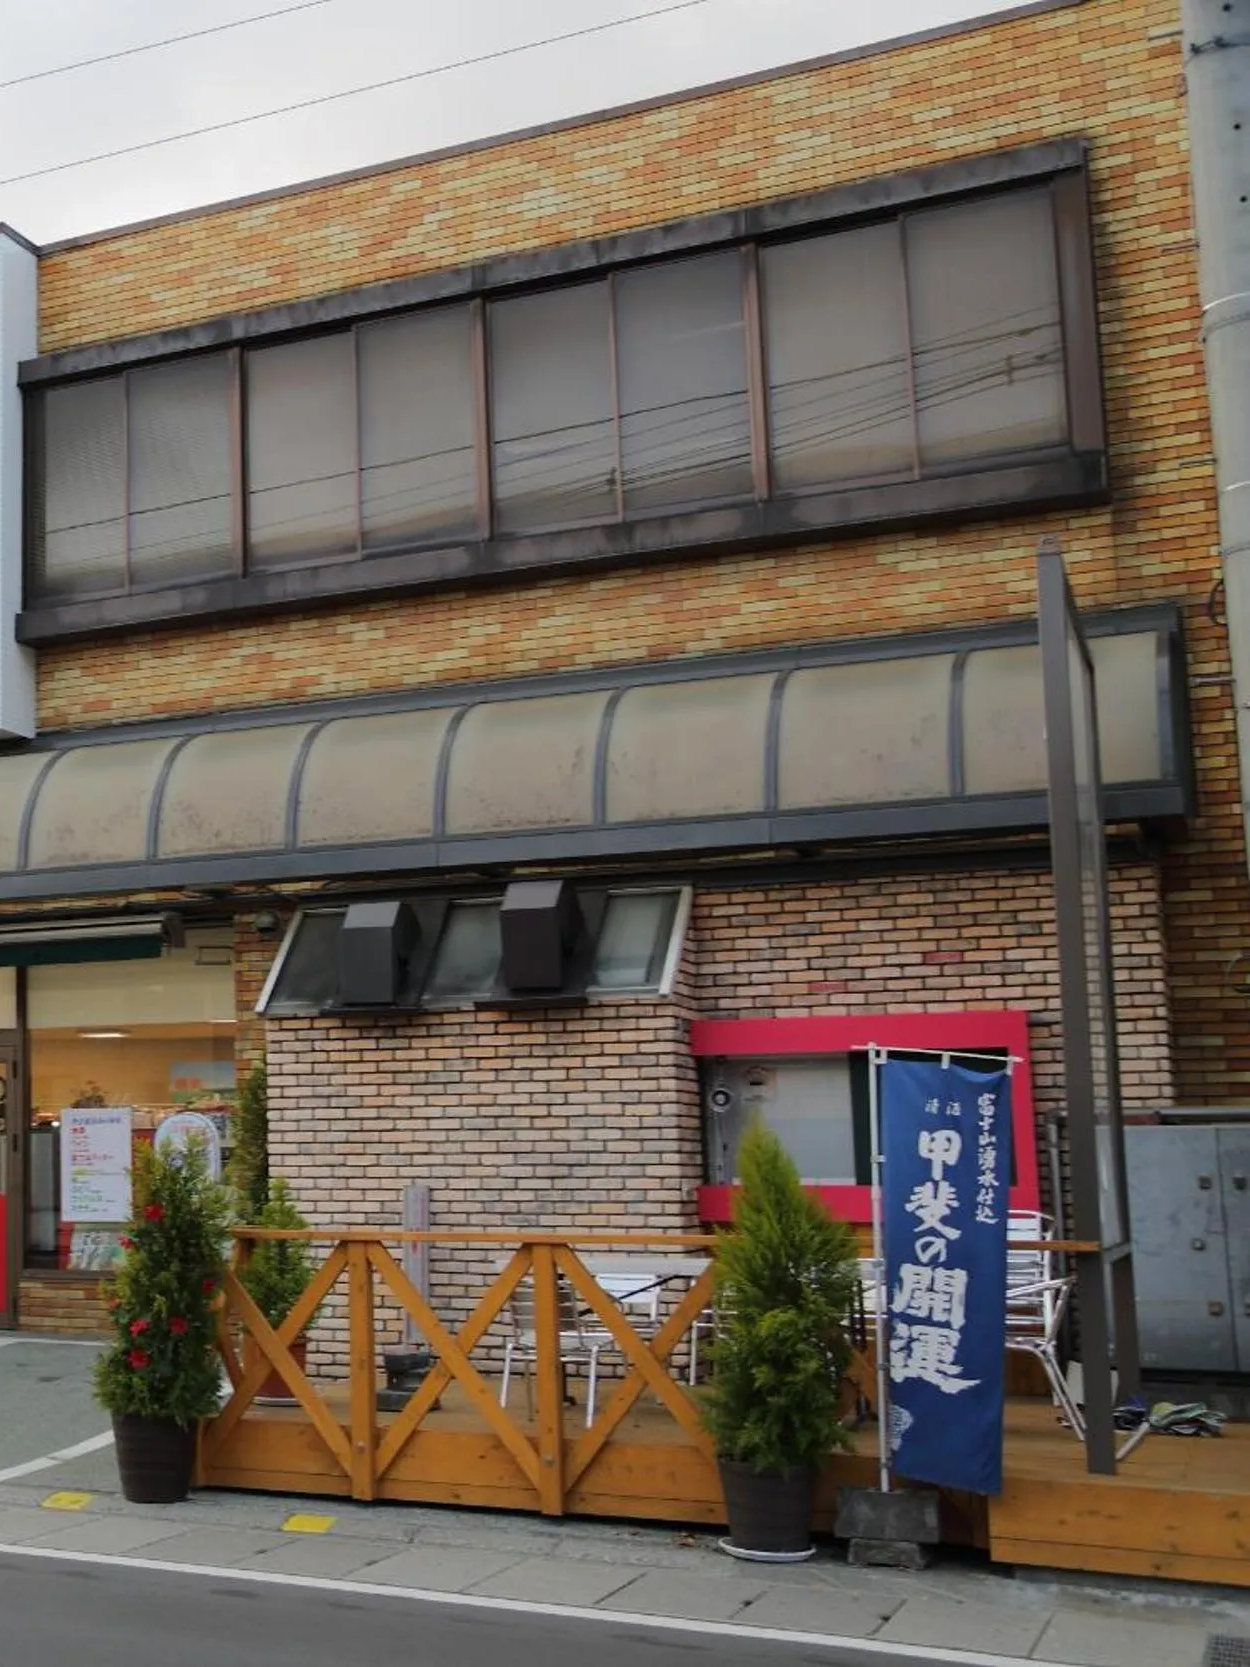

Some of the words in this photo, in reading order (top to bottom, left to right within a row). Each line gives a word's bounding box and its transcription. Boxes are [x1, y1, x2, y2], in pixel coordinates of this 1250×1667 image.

[889, 1128, 982, 1395] 甲斐の開運
